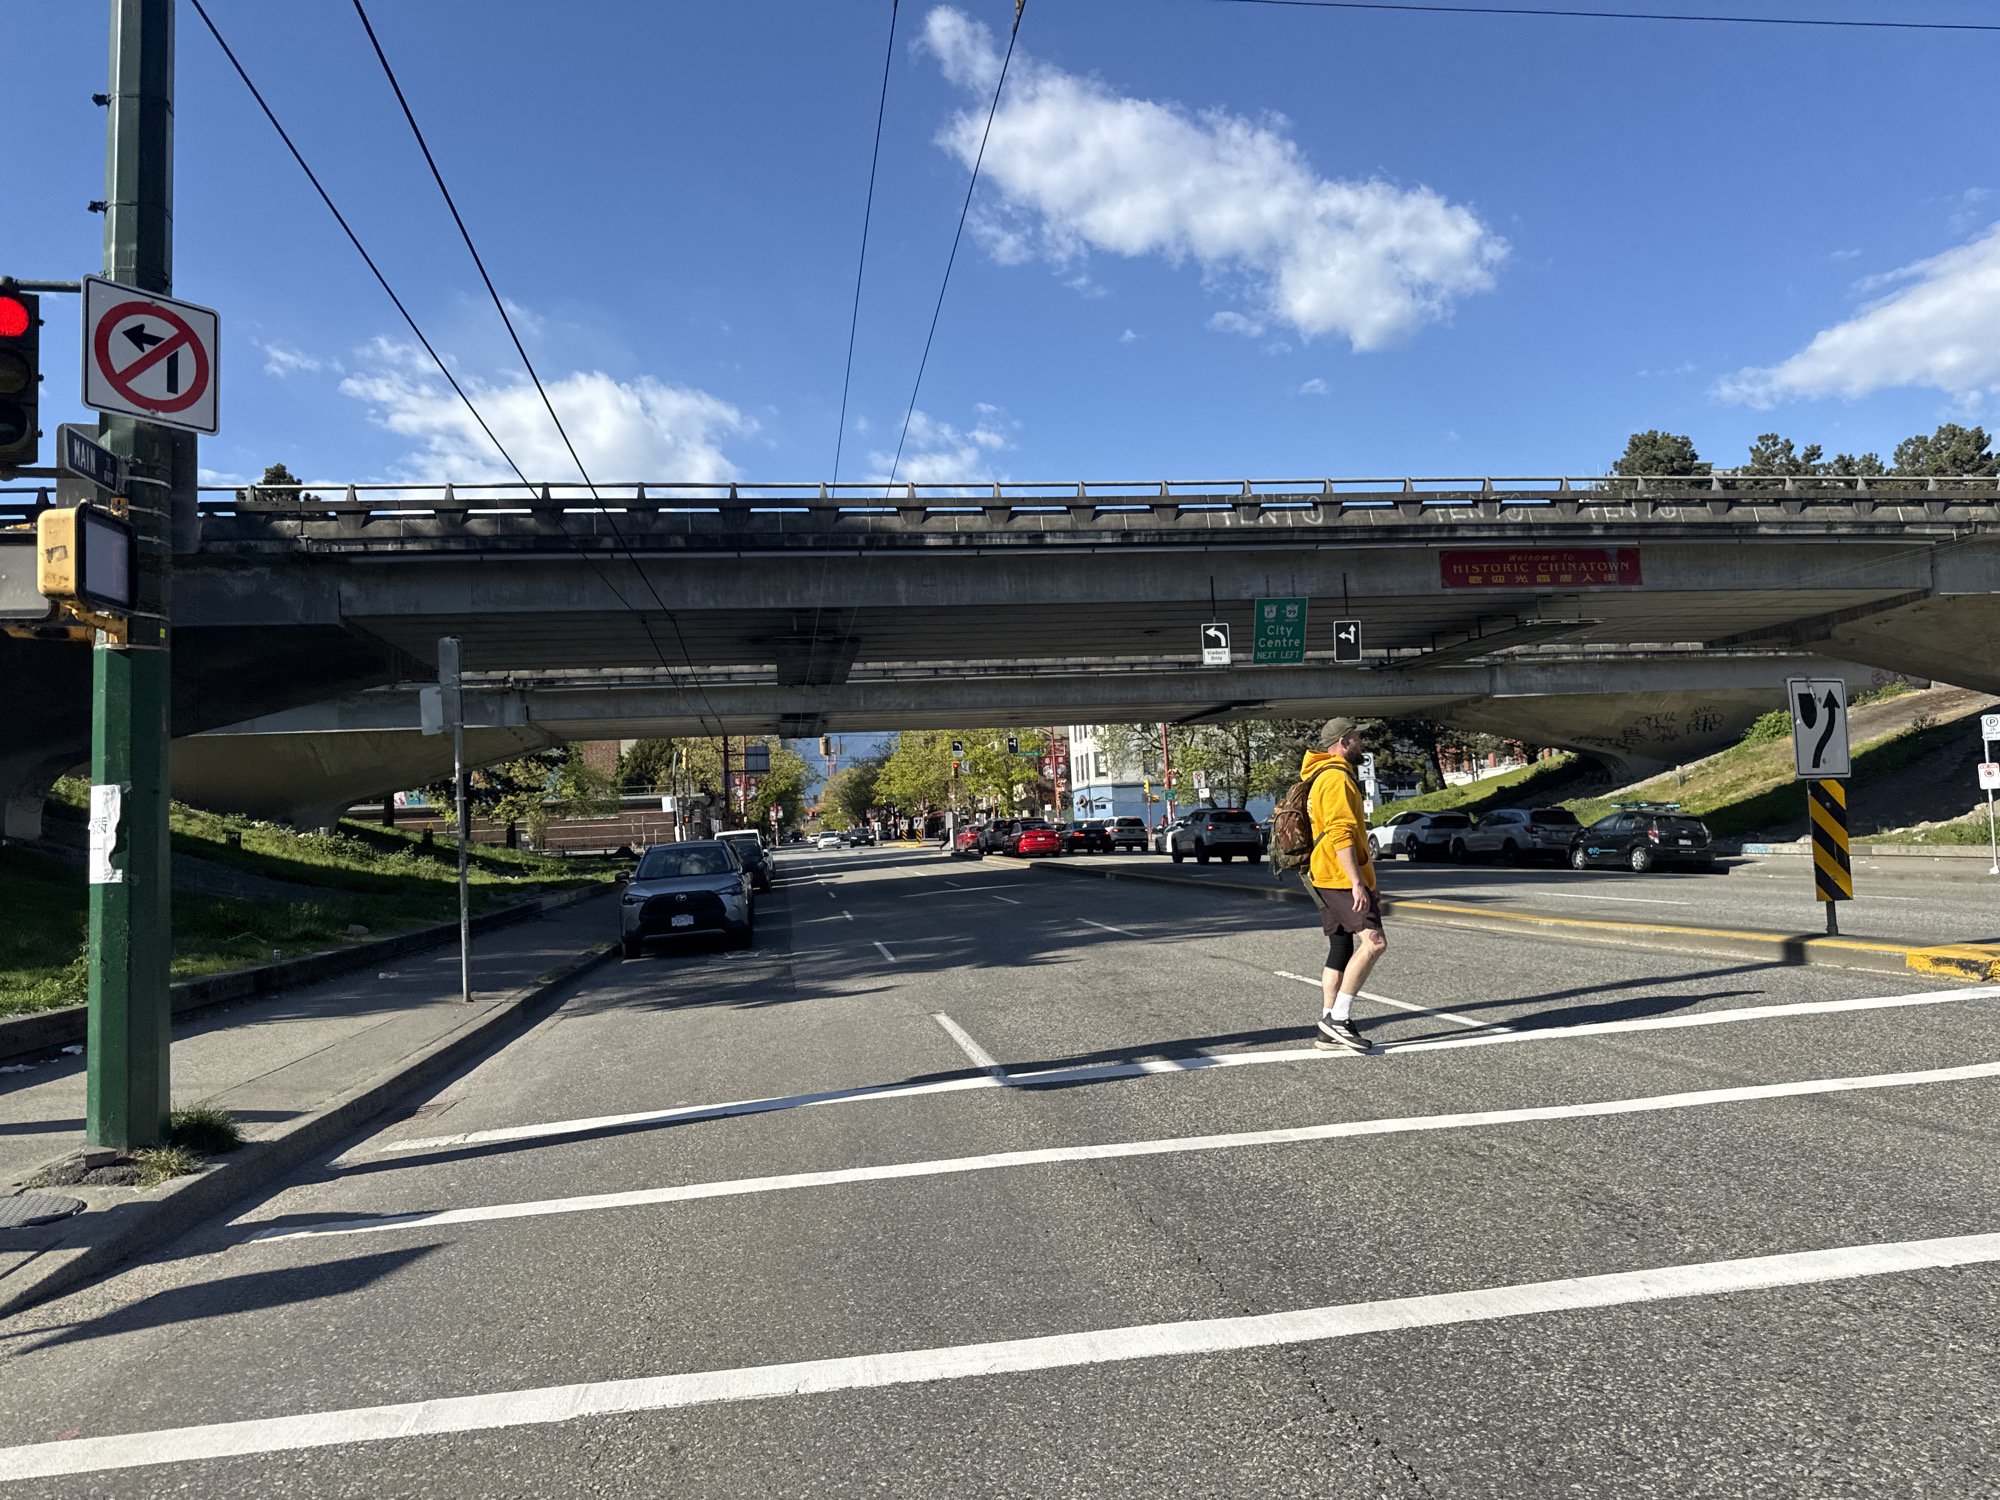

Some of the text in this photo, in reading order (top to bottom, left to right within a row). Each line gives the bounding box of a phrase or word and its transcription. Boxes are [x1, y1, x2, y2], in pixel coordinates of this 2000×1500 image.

[74, 438, 96, 475] MAIN
[1508, 553, 1556, 562] Welcome
[1453, 561, 1630, 574] HISTORIC CHINATOWN
[1266, 608, 1274, 617] 1A
[1266, 625, 1293, 637] City
[1258, 637, 1301, 648] Centre
[1256, 650, 1300, 659] NEXT LEFT
[1587, 846, 1600, 855] evo
